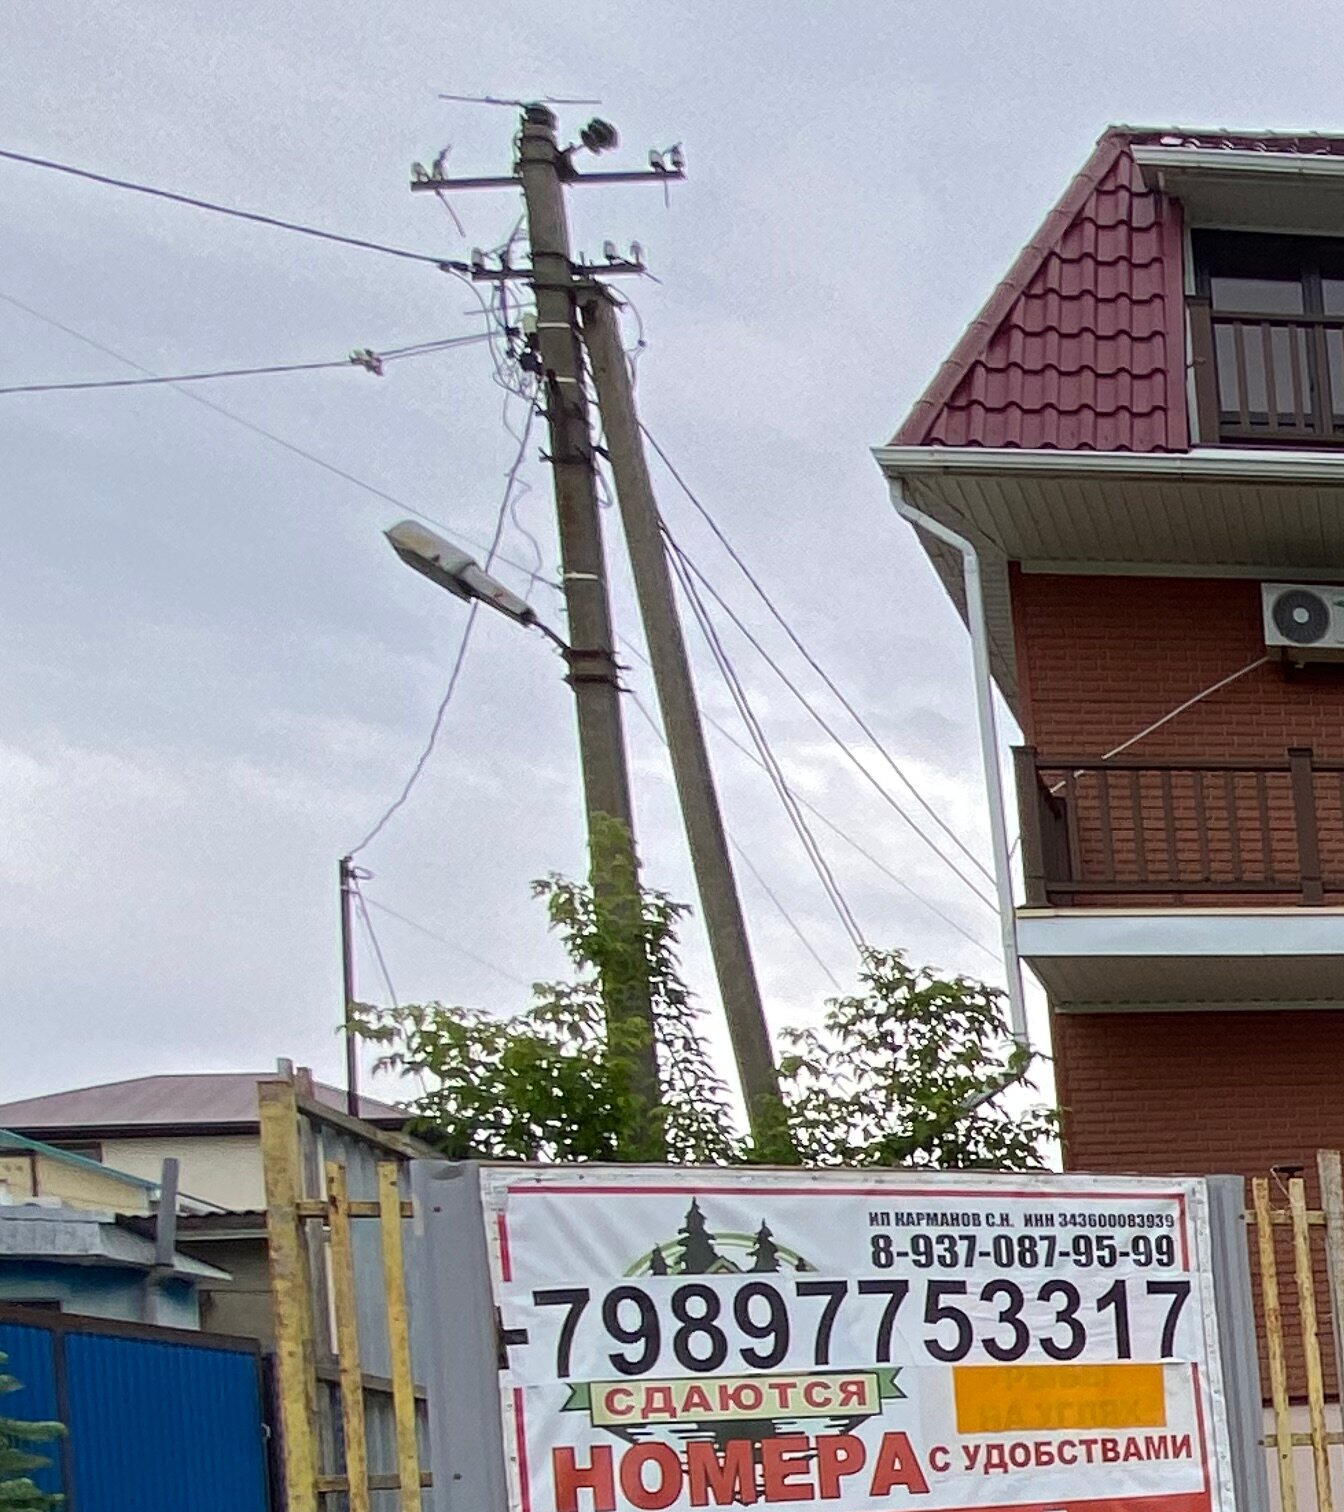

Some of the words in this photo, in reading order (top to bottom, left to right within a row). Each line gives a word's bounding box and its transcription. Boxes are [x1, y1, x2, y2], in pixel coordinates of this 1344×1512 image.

[868, 1211, 891, 1227] ИП
[894, 1211, 982, 1228] КАРМАНОВ
[1023, 1212, 1055, 1228] ИНН
[1057, 1212, 1175, 1229] 343600083939
[870, 1233, 1176, 1270] 8-937-087-95-99
[603, 1379, 867, 1420] СДАЮТСЯ
[961, 1433, 1193, 1475] УДОБСТВАМИ
